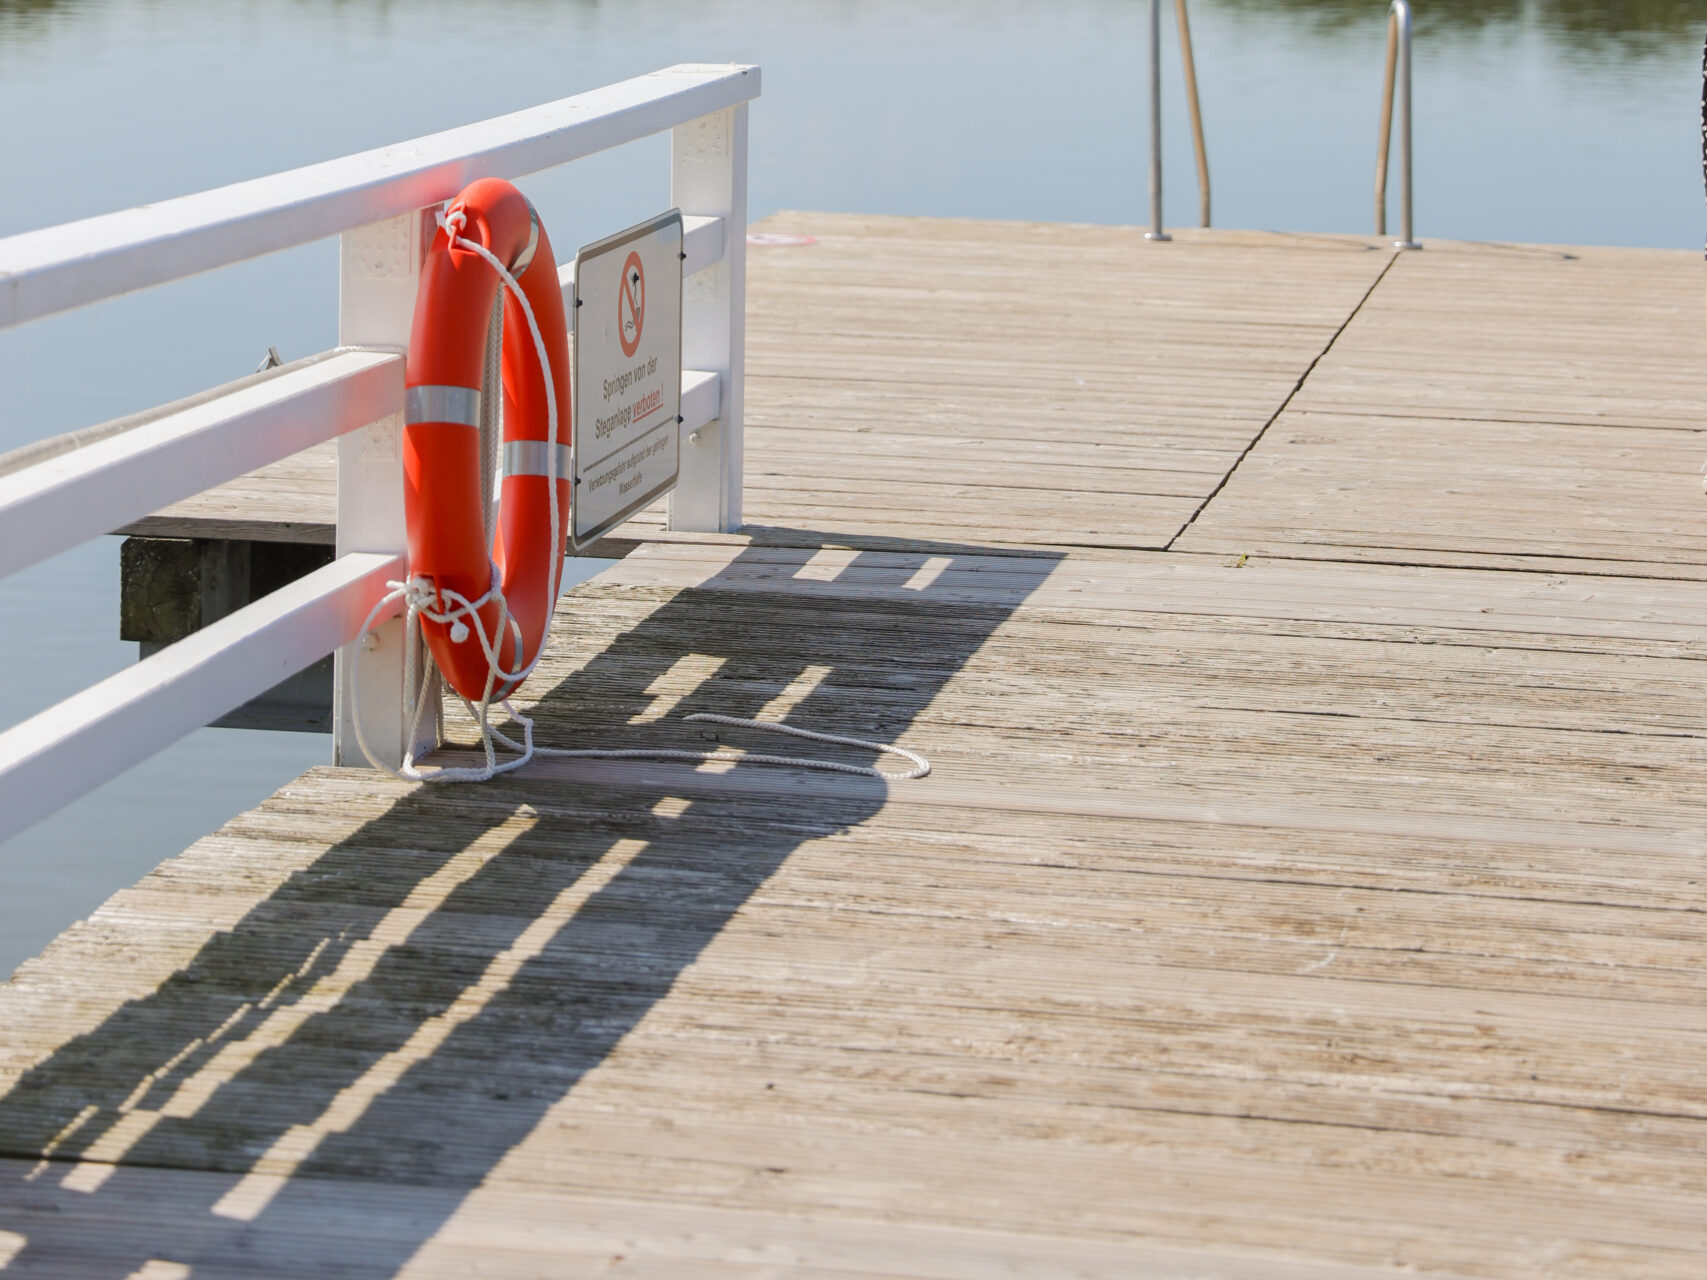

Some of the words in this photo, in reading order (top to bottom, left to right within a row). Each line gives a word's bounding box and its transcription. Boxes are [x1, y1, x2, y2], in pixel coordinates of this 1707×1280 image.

[603, 372, 632, 402] Springen
[634, 364, 646, 382] von
[647, 355, 658, 374] der
[595, 405, 632, 440] Steganlage
[633, 389, 660, 416] verboten
[627, 450, 645, 471] aufgrund
